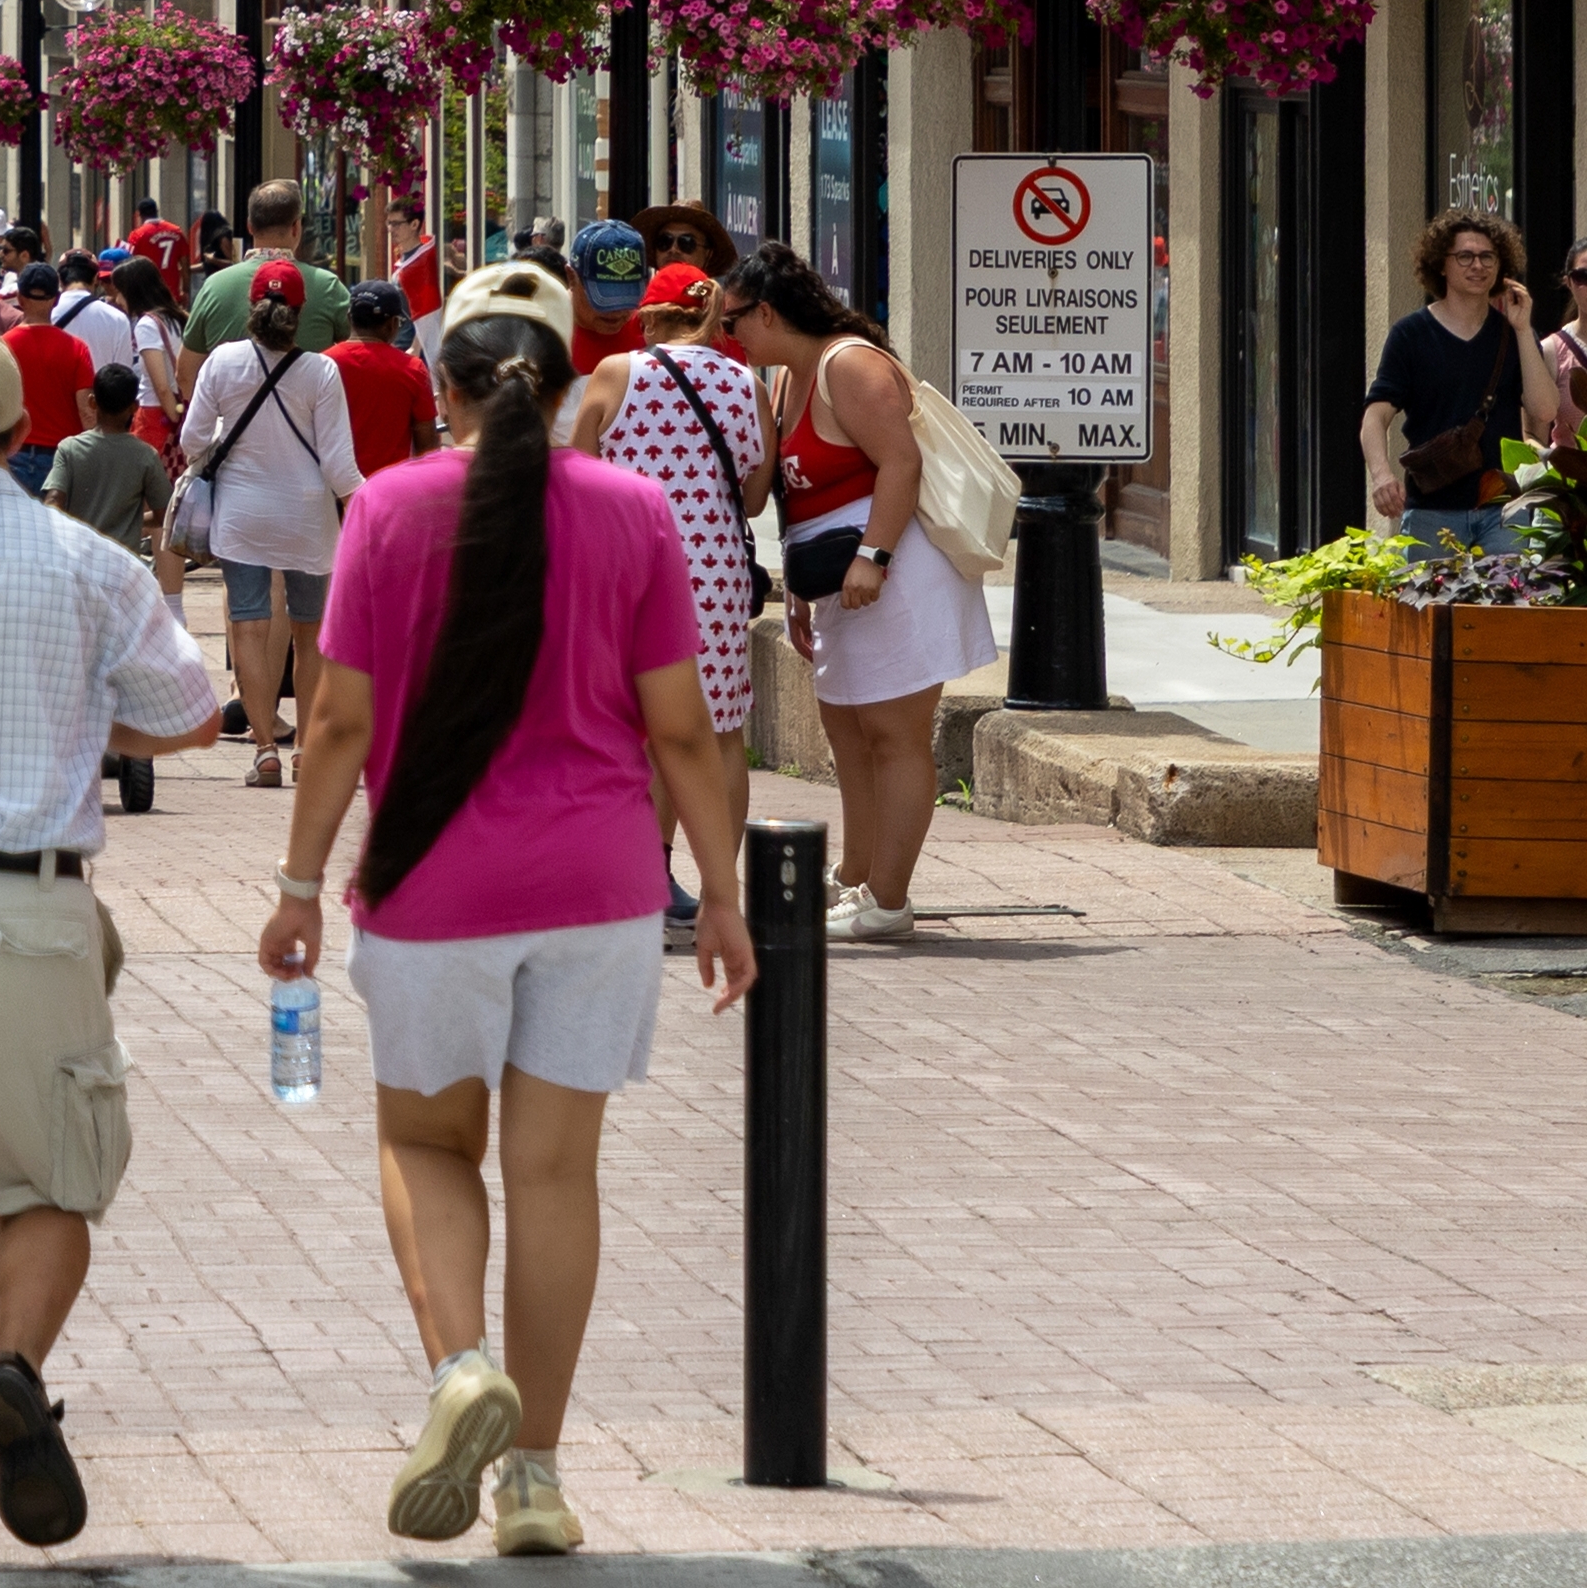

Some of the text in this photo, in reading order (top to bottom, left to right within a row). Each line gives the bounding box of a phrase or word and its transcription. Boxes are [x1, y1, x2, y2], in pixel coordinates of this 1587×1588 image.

[821, 100, 849, 142] LEASE
[1449, 153, 1499, 213] Esthetics
[158, 240, 174, 269] 7
[596, 247, 642, 266] CANADA
[969, 249, 1134, 270] DELIVERIES ONLY
[965, 288, 1138, 308] POUR LIVRAISONS
[995, 315, 1109, 335] SEULEMENT
[970, 352, 984, 373] 7
[992, 352, 1033, 373] AM
[1060, 352, 1085, 374] 10
[1090, 353, 1132, 374] AM
[962, 385, 1003, 396] PERMIT
[962, 388, 1134, 408] REQUIRED AFTER 10 AM
[999, 422, 1052, 446] MIN.
[1078, 424, 1142, 448] MAX.
